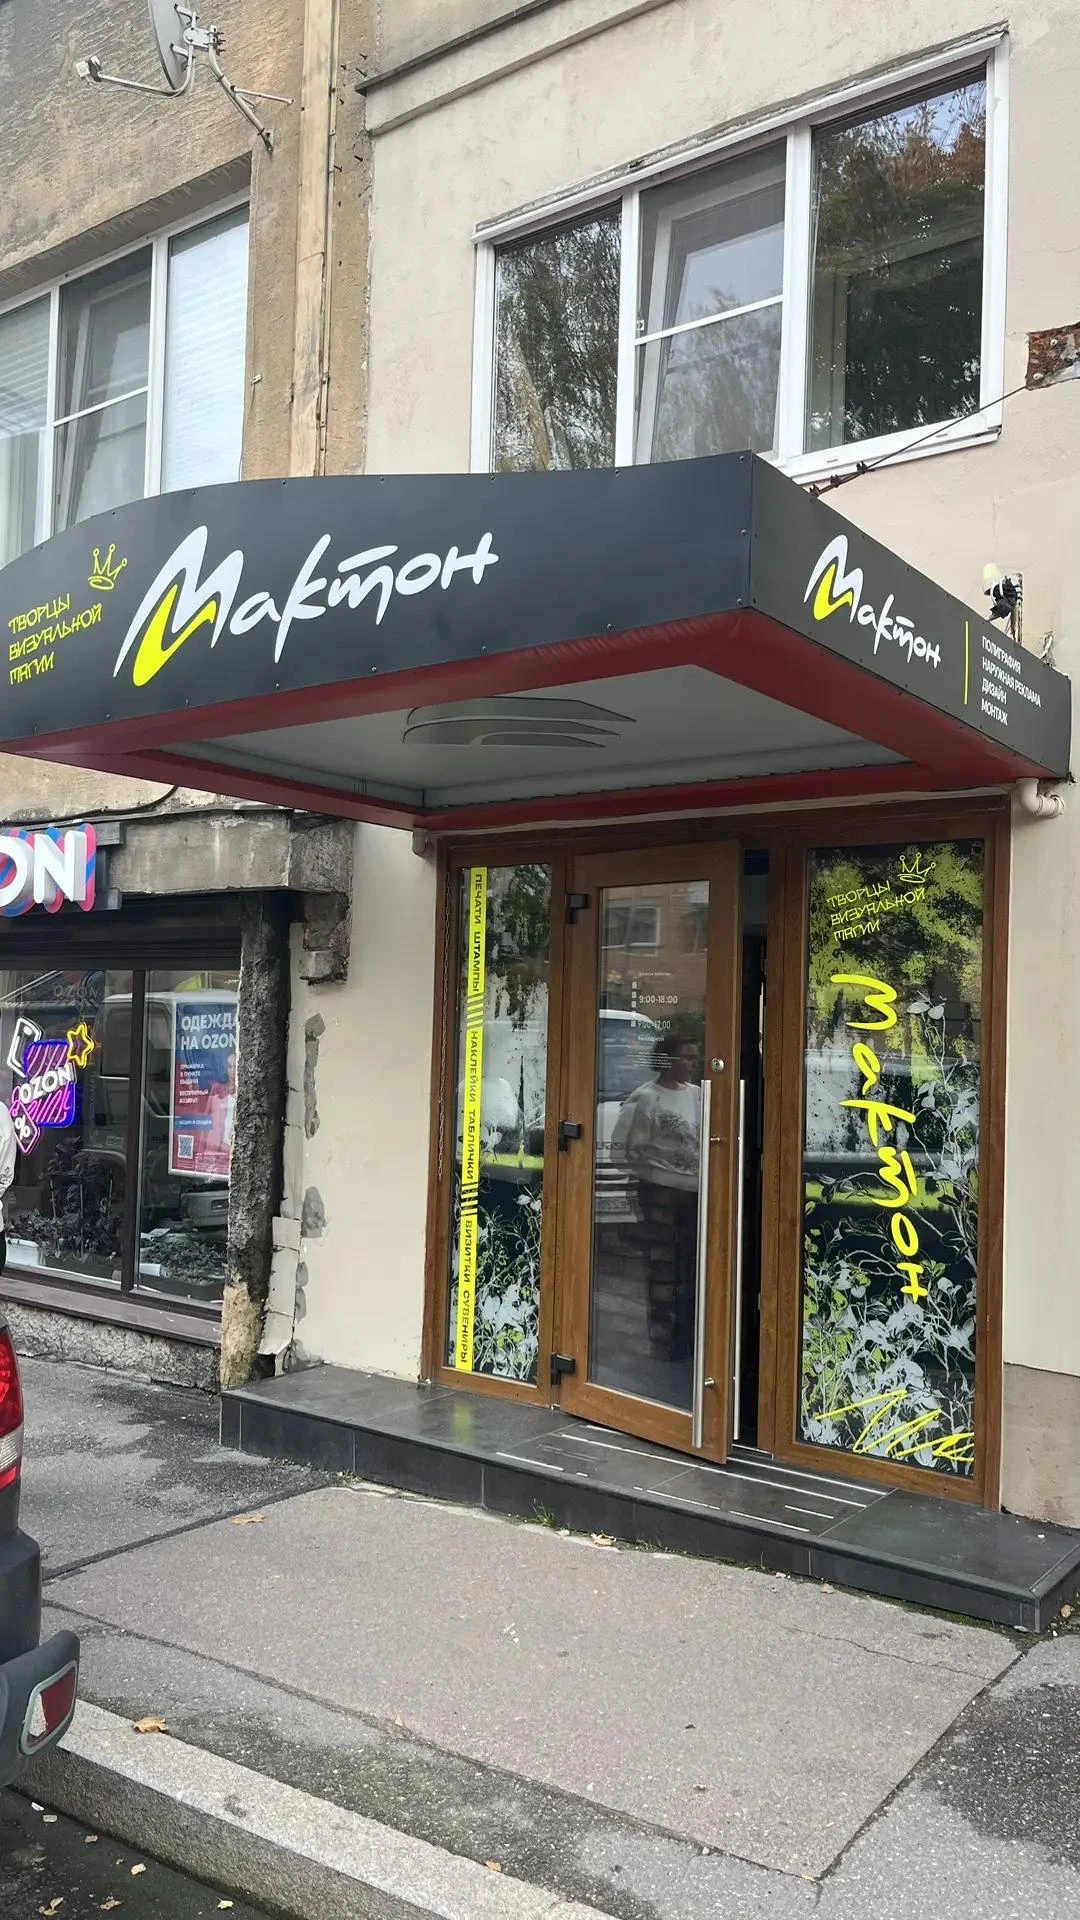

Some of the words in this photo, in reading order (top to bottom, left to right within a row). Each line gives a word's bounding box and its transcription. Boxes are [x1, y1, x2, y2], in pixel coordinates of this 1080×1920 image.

[8, 592, 71, 635] ТВОРЦЫ
[113, 525, 499, 687] Мактон
[803, 534, 942, 669] Мактон
[9, 602, 103, 661] ВИЗУАЛЬНОЙ
[981, 635, 1022, 675] ПОЛИГРАФИЯ
[981, 655, 1015, 690] НАРУЖНАЯ
[1014, 679, 1042, 708] РЕКЛАМА
[981, 677, 1008, 705] ДИЗАЙН
[981, 698, 1009, 726] МОНТАЖ
[474, 874, 483, 925] ПЕЧАТИ
[826, 879, 891, 908] ТВОРЦЫ
[830, 886, 926, 926] ВИЗУАЛЬНОЙ
[472, 931, 481, 992] ШТАМПЫ
[181, 1035, 199, 1051] НА
[468, 1030, 479, 1103] НАКЛЕЙКИ
[19, 1065, 75, 1105] OZON
[466, 1109, 476, 1180] ТАБЛИЧКИ
[463, 1220, 473, 1283] ВИЗИТКИ
[460, 1289, 470, 1363] СУВЕНИРЫ
